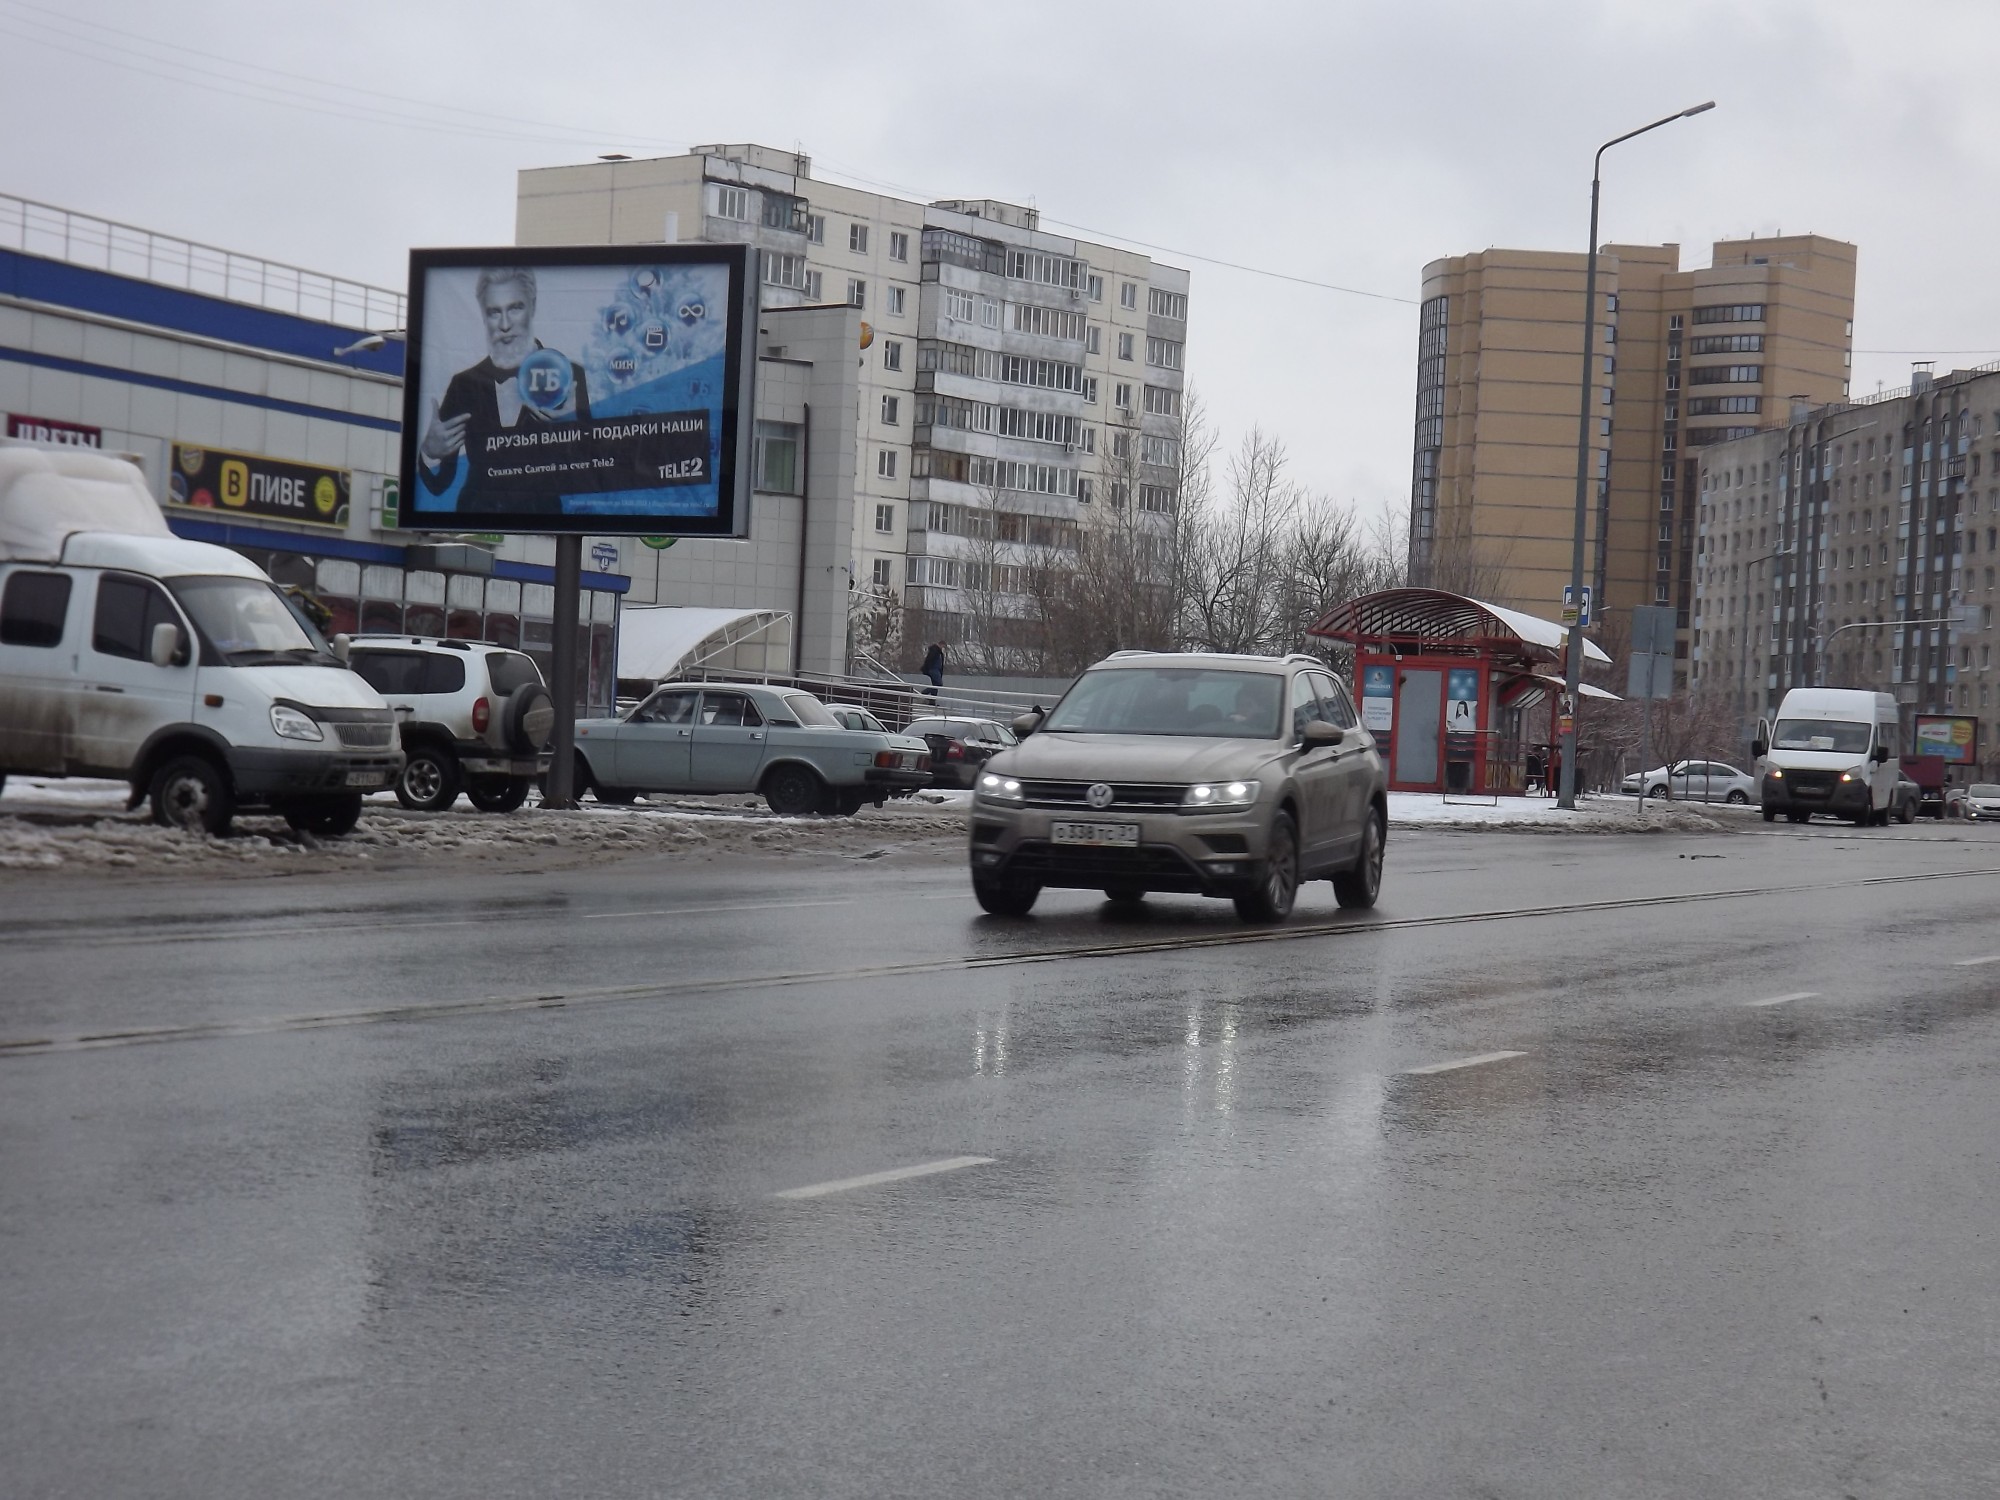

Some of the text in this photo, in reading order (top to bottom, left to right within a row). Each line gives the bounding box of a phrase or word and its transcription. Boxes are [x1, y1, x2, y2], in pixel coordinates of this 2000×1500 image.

[529, 368, 560, 392] ГБ
[486, 433, 538, 451] ДРУЗЬЯ
[541, 429, 581, 445] ВАШИ
[593, 423, 657, 440] ПОДАРКИ
[662, 419, 703, 435] НАШИ
[487, 467, 522, 477] Станьте
[525, 462, 556, 474] Сантой
[570, 461, 590, 470] счет
[592, 457, 615, 468] Tele2
[658, 457, 703, 480] TELE2
[228, 469, 241, 497] В
[251, 473, 306, 508] ПИВЕ
